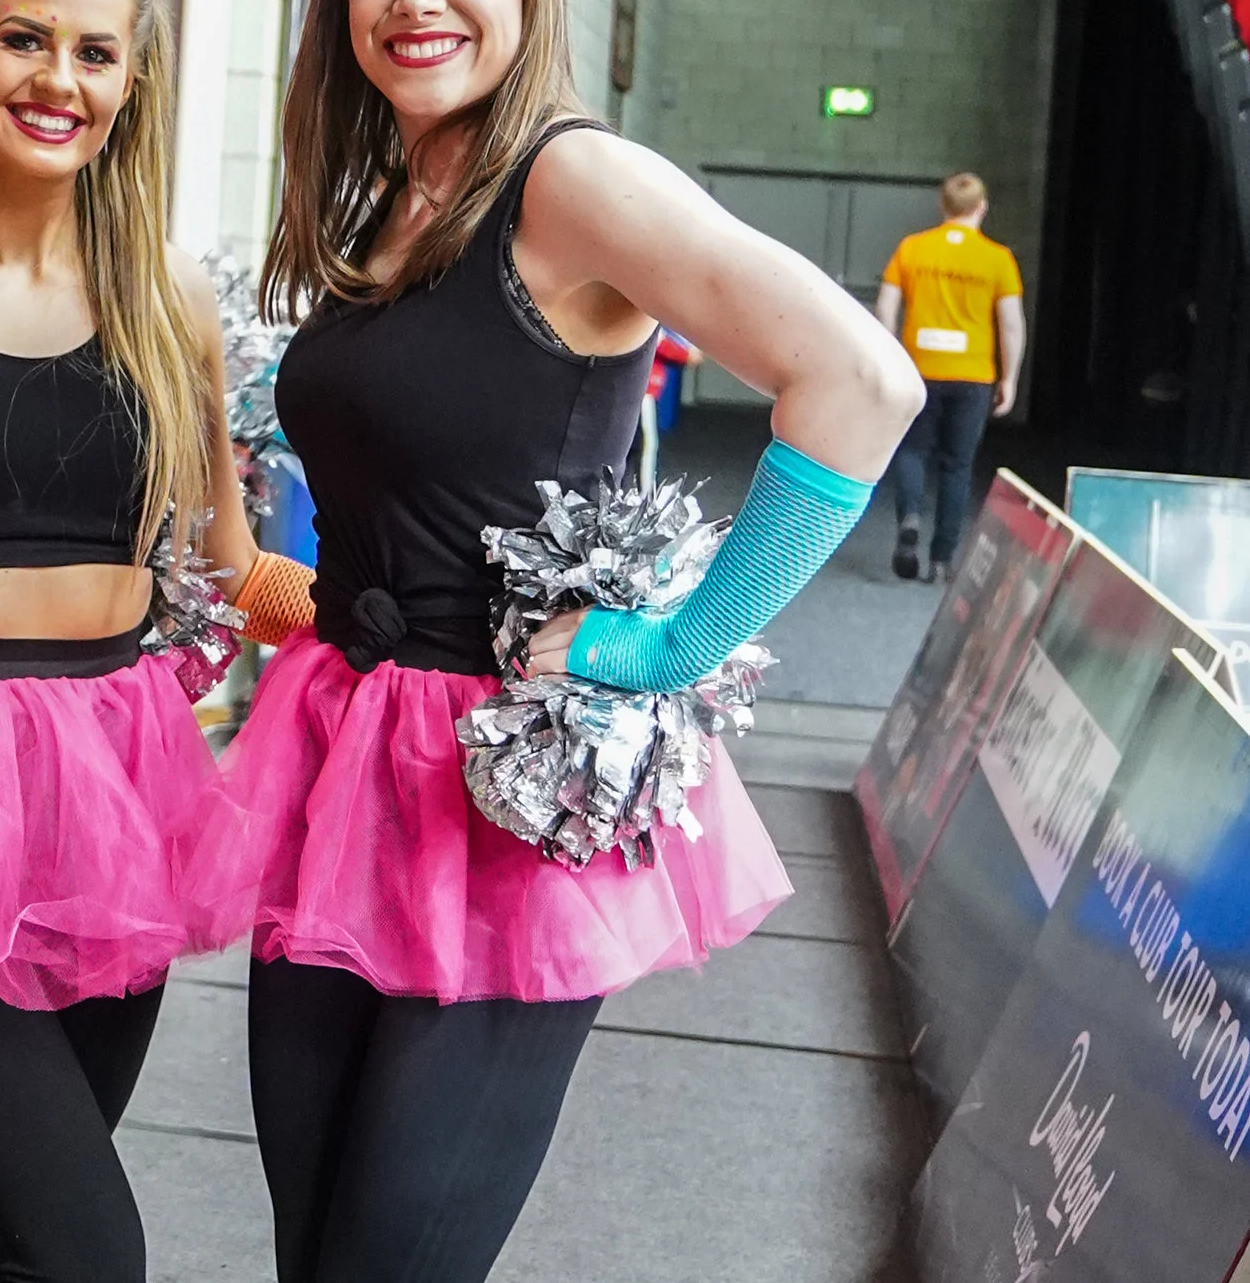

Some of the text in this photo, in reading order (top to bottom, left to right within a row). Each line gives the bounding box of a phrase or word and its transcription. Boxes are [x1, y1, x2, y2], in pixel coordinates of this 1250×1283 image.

[1093, 807, 1143, 909] BOOK
[1119, 861, 1150, 928] A
[1130, 880, 1180, 983] CLUB
[1156, 930, 1217, 1060] TOUR
[1029, 1030, 1116, 1256] David Lloyd
